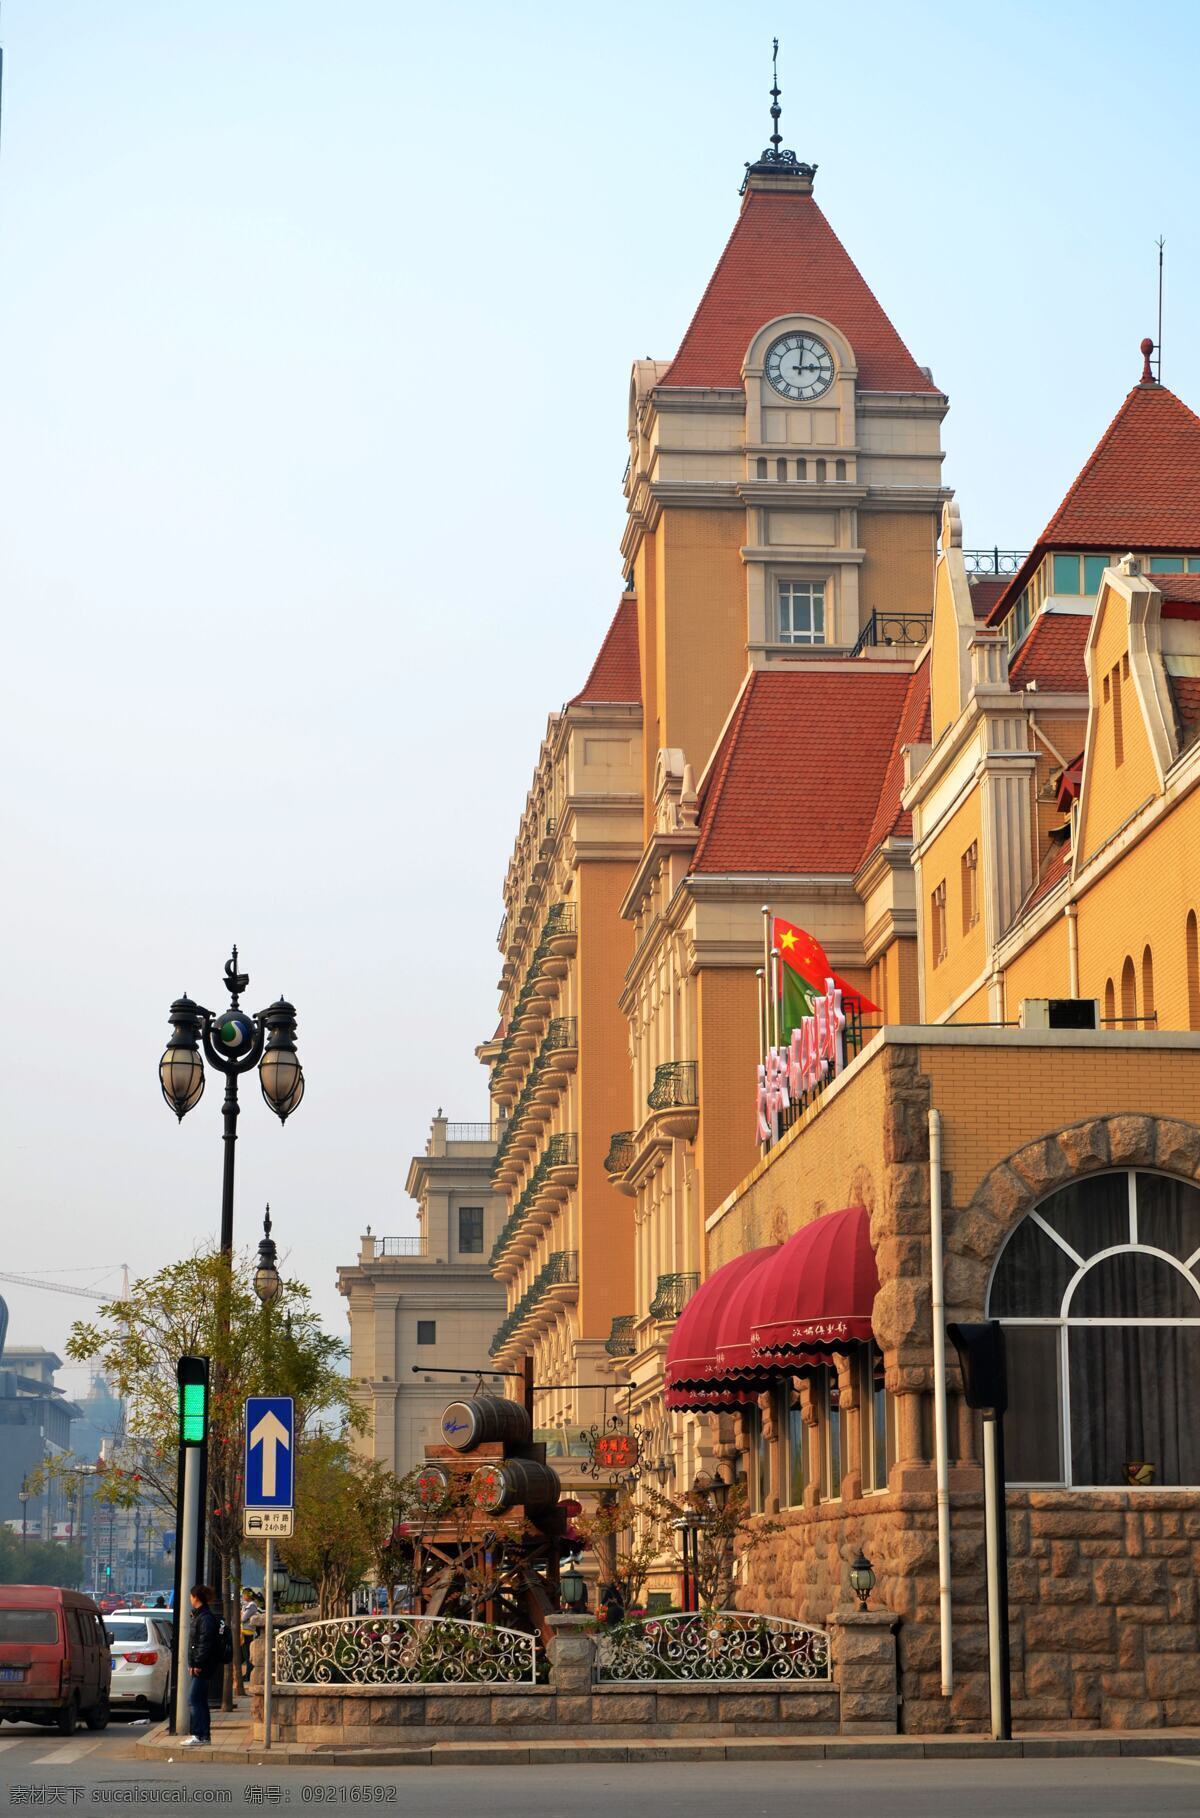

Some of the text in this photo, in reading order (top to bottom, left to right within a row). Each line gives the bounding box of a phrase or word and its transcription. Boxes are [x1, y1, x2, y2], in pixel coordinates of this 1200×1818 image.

[264, 1514, 289, 1522] 单行路
[264, 1524, 287, 1532] 24小时
